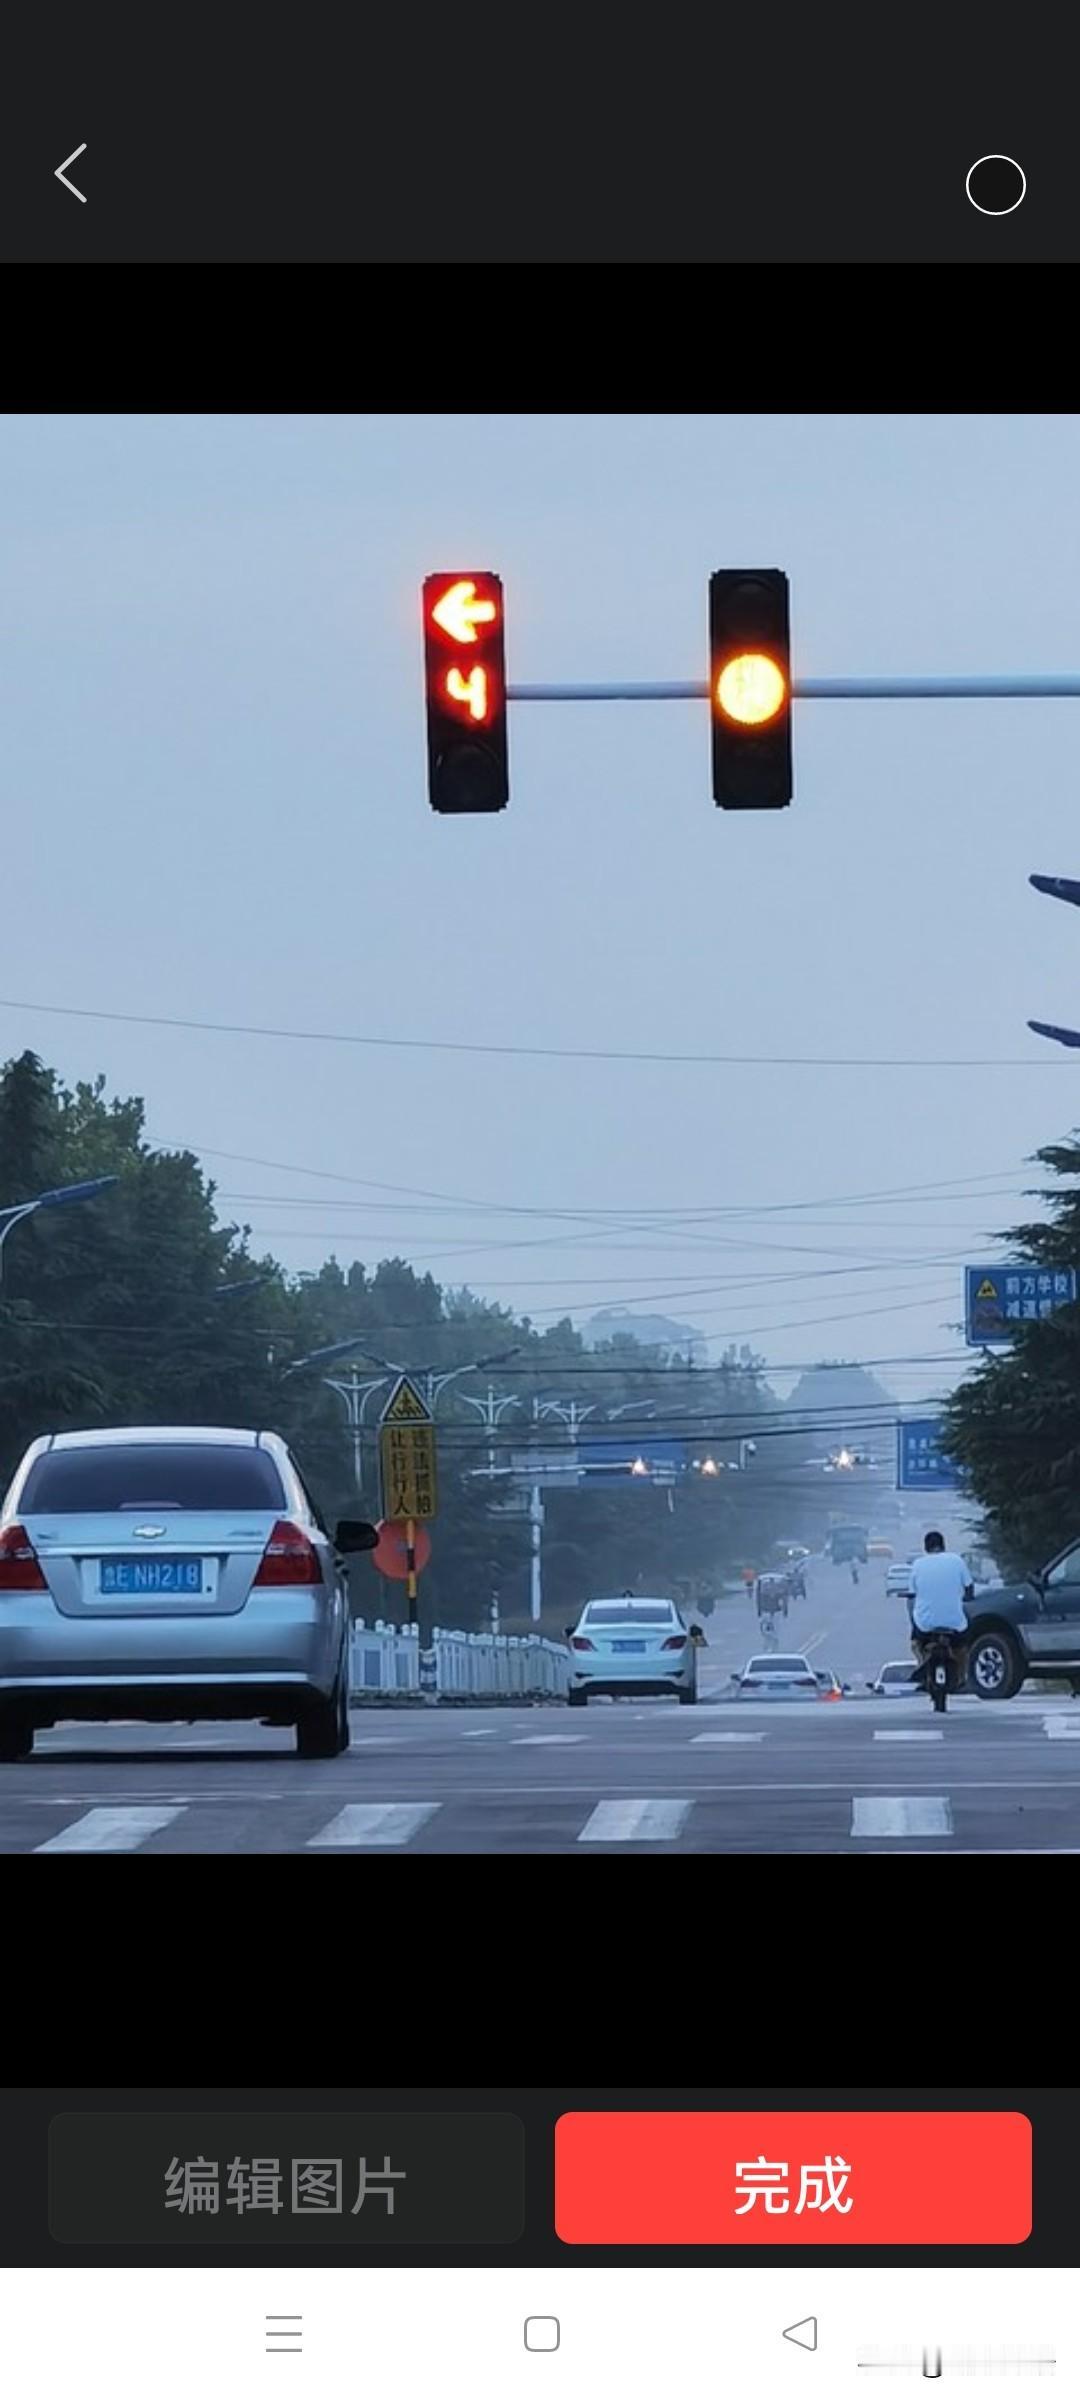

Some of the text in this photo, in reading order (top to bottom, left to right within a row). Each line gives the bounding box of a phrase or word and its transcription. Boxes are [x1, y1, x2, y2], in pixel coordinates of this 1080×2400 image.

[446, 666, 486, 720] 4
[1006, 1274, 1067, 1294] 前方学校
[1007, 1297, 1069, 1319] 减速慢
[391, 1429, 410, 1515] 让行行人
[413, 1428, 432, 1515] 违法抓拍
